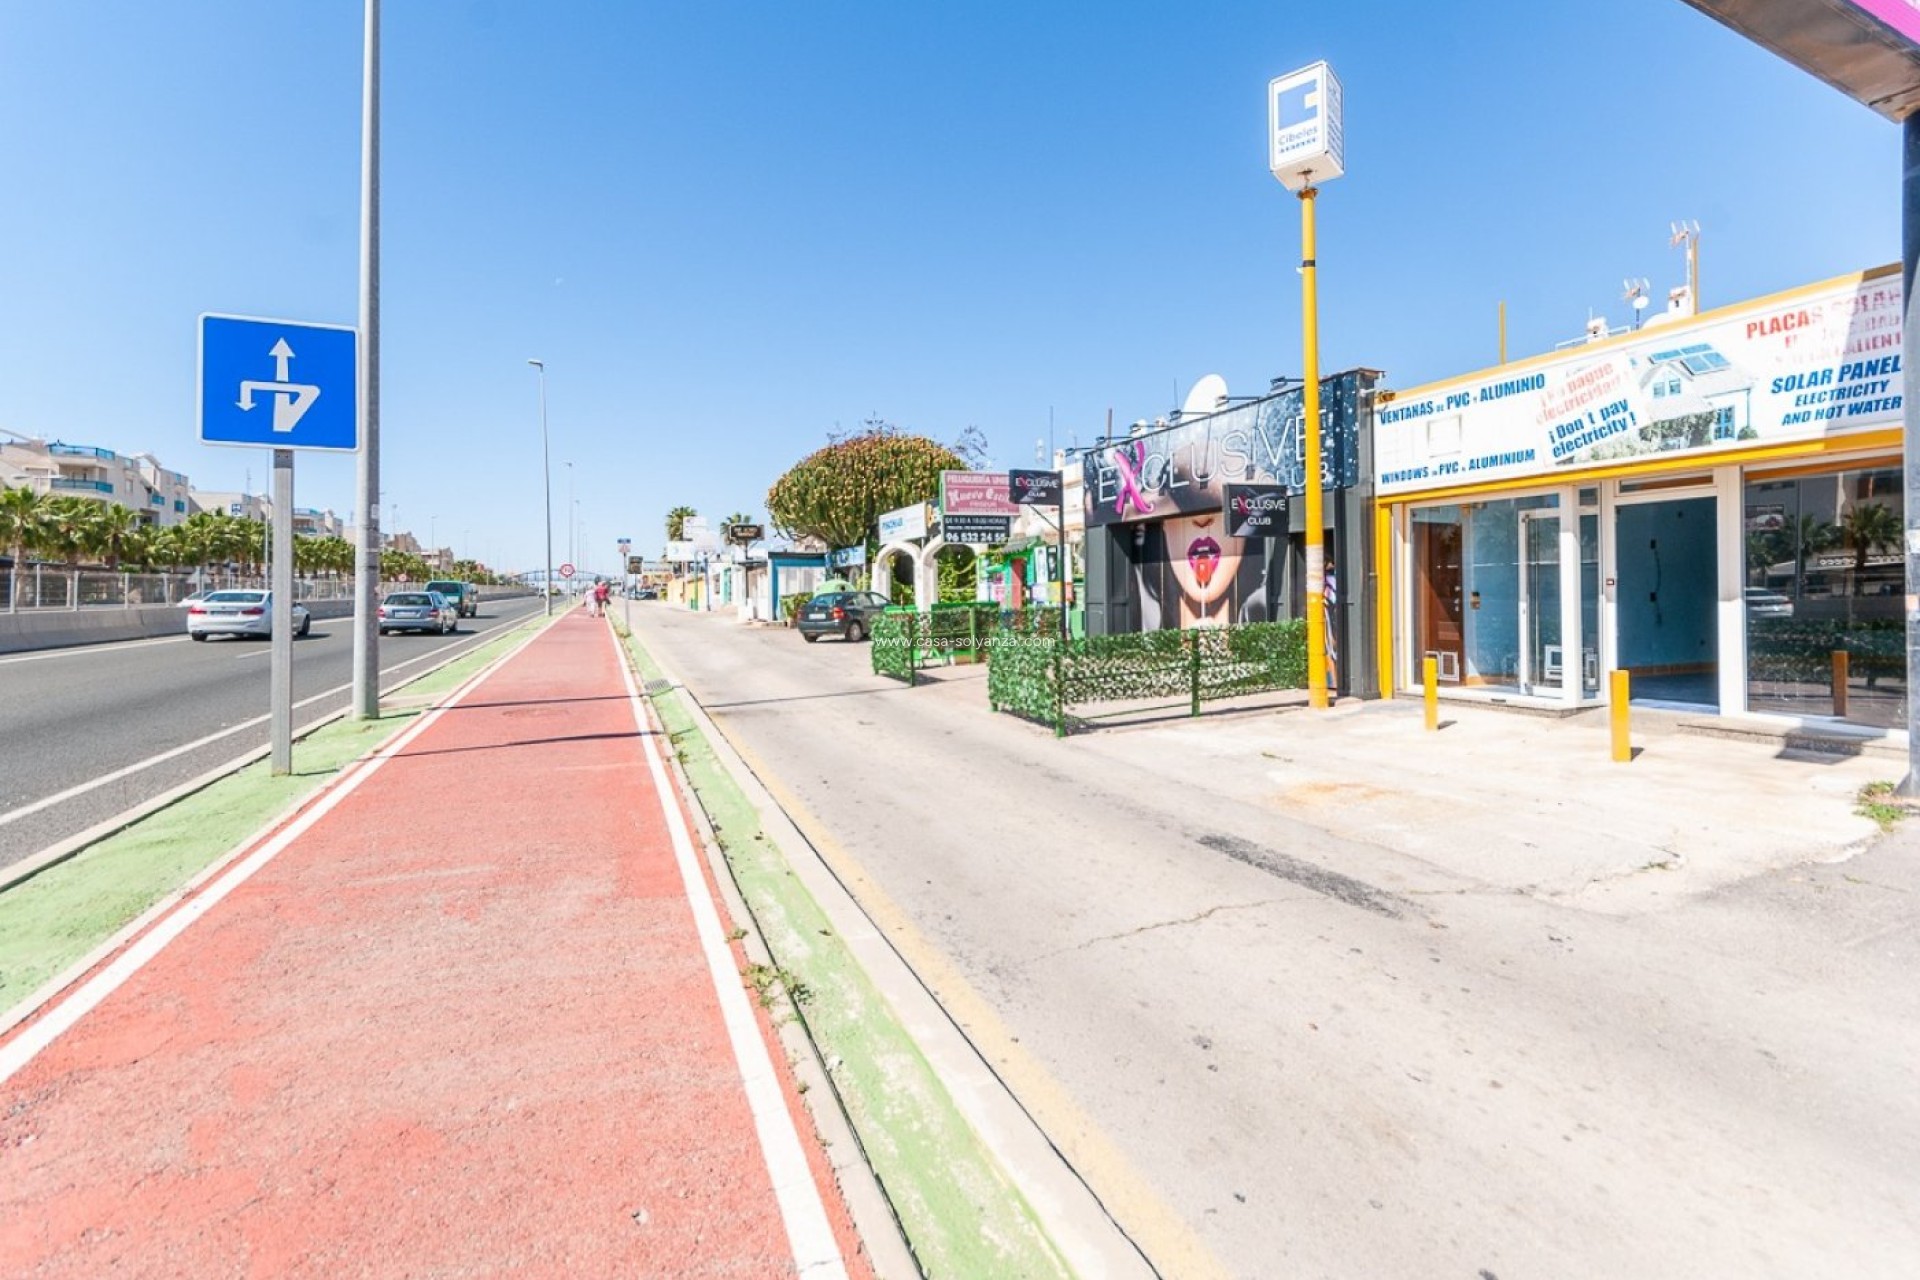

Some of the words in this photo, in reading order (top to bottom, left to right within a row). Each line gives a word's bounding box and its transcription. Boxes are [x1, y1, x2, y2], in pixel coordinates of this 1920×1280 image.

[1278, 126, 1318, 147] Cibeles
[1747, 305, 1823, 339] PLACAS
[1771, 367, 1833, 394] SOLAR
[1838, 354, 1902, 383] PANEL
[1380, 400, 1434, 425] VENTANAS
[1446, 391, 1470, 411] PVC
[1480, 373, 1545, 402] ALUMINIO
[1795, 379, 1890, 407] ELECTRICITY
[1600, 398, 1628, 421] pay
[1782, 410, 1813, 426] AND
[1814, 404, 1846, 421] HOT
[1848, 396, 1903, 416] WATER
[1098, 407, 1327, 515] EXCLUSIVE
[1381, 466, 1429, 485] WINDOWS
[1439, 461, 1459, 476] PVC
[1469, 449, 1535, 471] ALUMINIUM
[1015, 475, 1059, 491] EXCLUSIVE
[1231, 494, 1286, 515] EXCLUSIVE
[1247, 516, 1272, 526] CLUB
[946, 532, 959, 541] 96
[961, 532, 978, 541] 532
